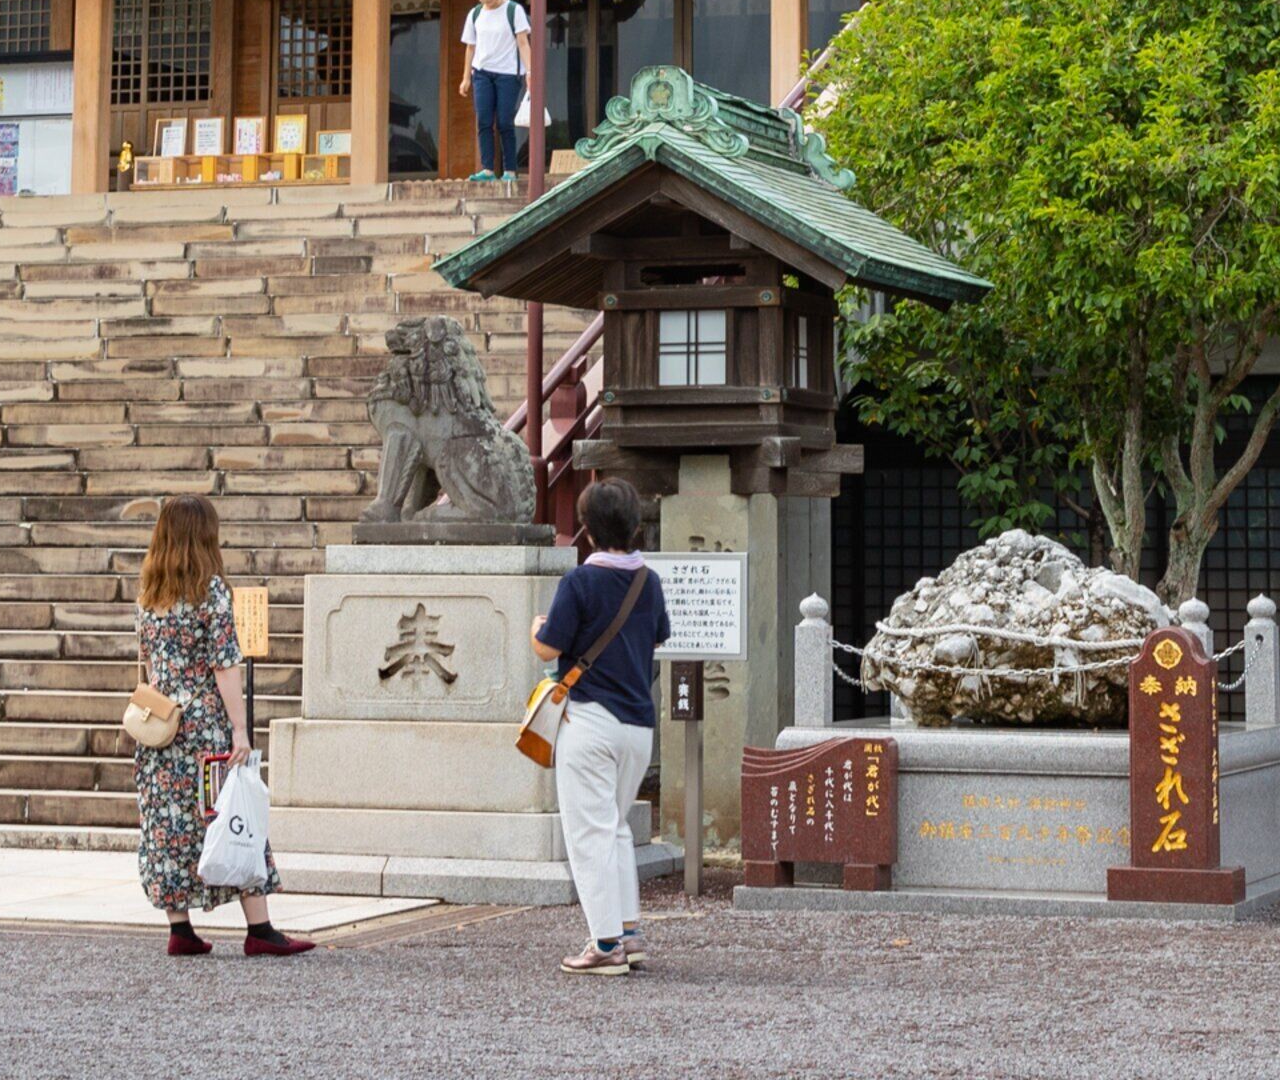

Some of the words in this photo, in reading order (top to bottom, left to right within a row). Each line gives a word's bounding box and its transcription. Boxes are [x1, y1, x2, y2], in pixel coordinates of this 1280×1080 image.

[672, 564, 710, 575] さざれ石
[377, 602, 458, 686] 奉
[1139, 674, 1197, 697] 奉納
[824, 766, 835, 842] 千代に八千代に
[843, 759, 853, 802] 君が代は
[865, 756, 880, 817] 「君が代」
[1151, 702, 1190, 853] さざれ石
